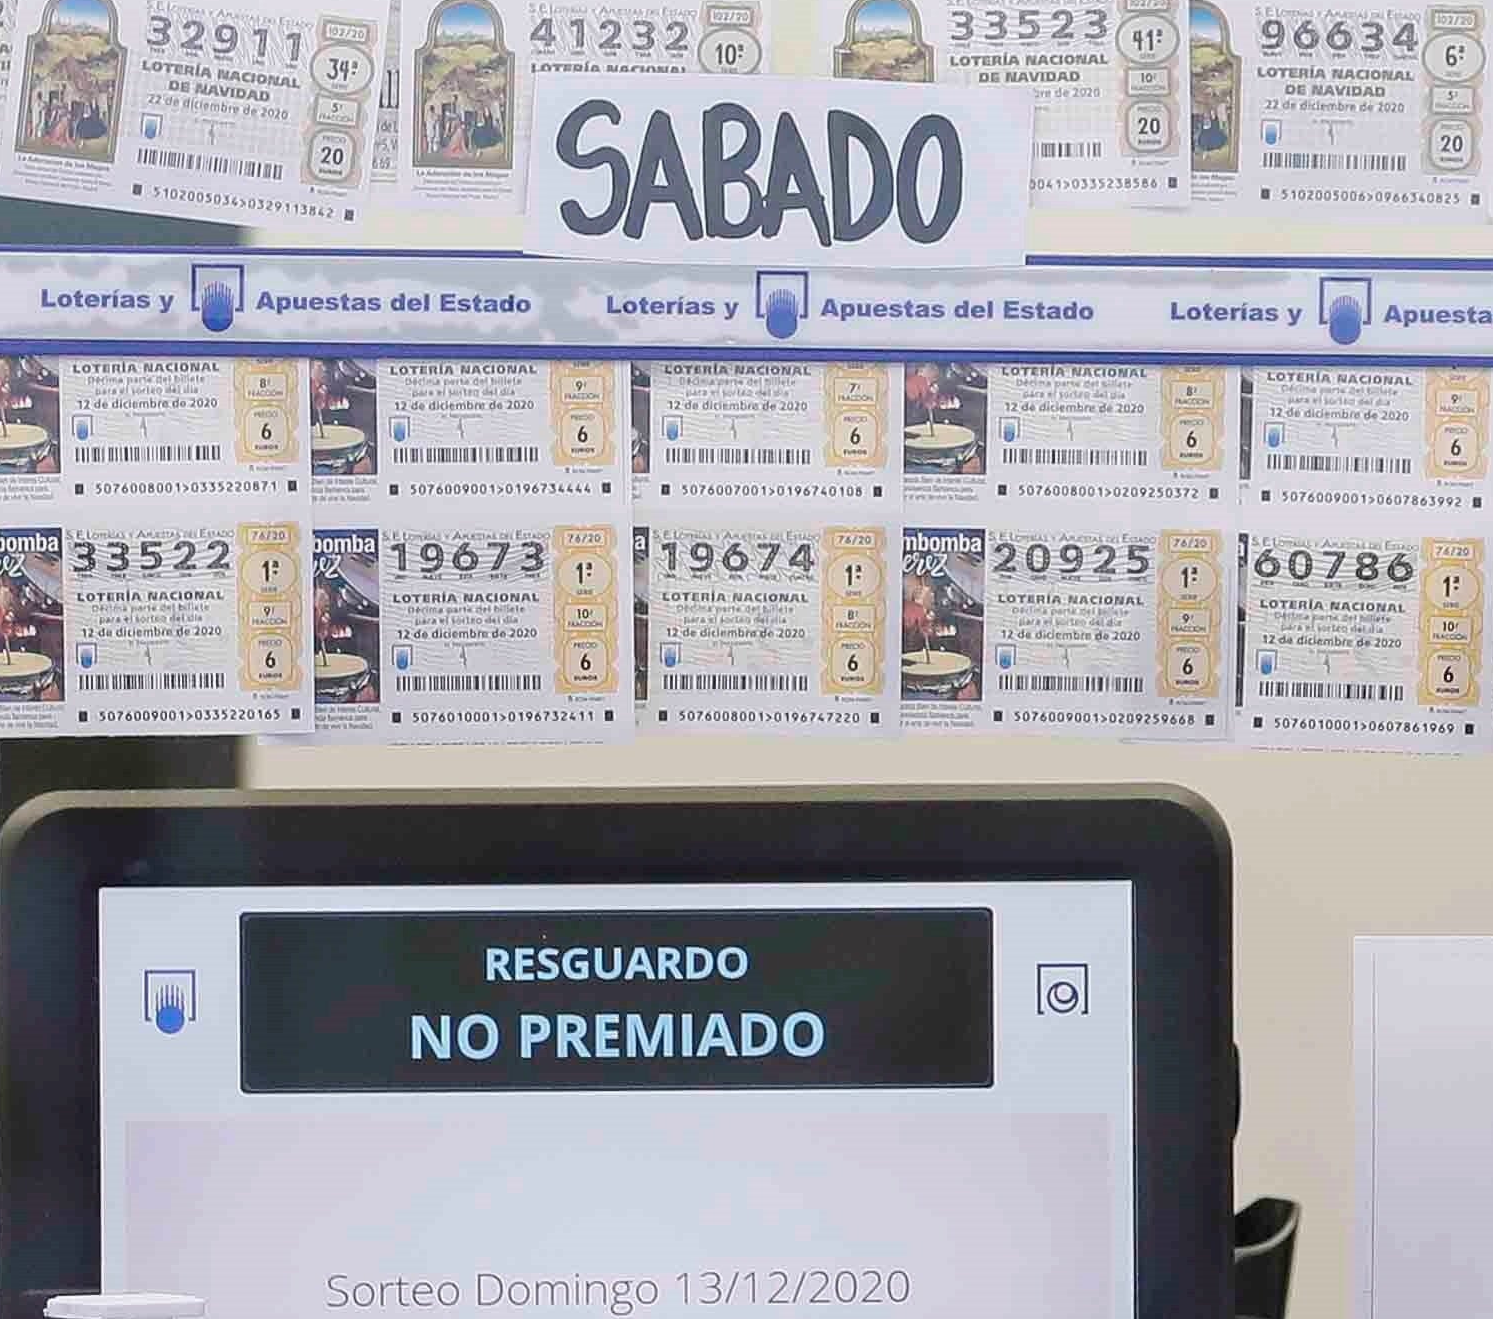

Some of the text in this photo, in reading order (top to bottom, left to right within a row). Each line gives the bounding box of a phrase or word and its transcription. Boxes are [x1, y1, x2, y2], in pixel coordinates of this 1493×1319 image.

[556, 99, 963, 247] SABADO
[71, 539, 230, 573] 33522
[390, 541, 545, 575] 19673
[661, 539, 816, 575] 19674
[992, 542, 1150, 575] 20925
[486, 946, 748, 981] RESGUARDO
[411, 1011, 824, 1060] NO PREMIADO
[326, 1270, 910, 1316] Sorteo Domingo 13/12/2020
